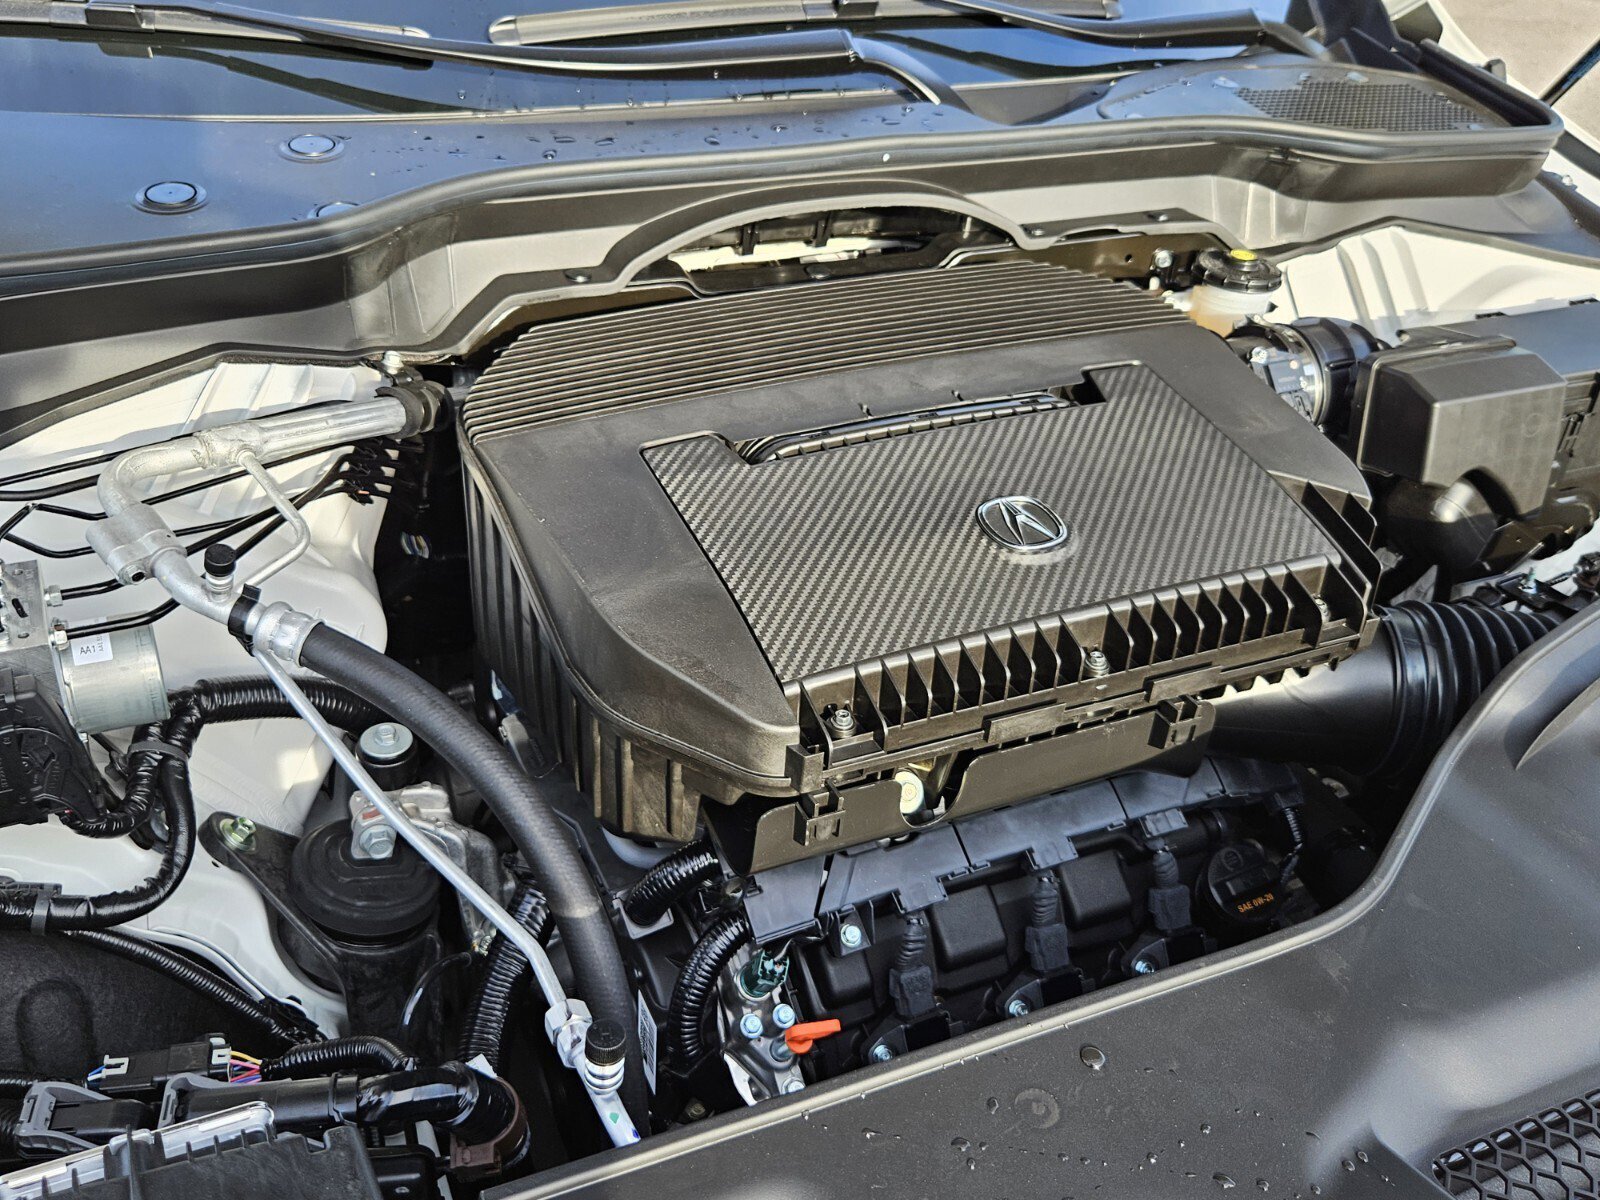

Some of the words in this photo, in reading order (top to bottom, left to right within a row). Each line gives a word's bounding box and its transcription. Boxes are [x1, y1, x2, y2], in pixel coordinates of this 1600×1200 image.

[80, 645, 96, 655] AA1
[1237, 901, 1253, 912] SAE
[1253, 893, 1274, 906] 0W-20
